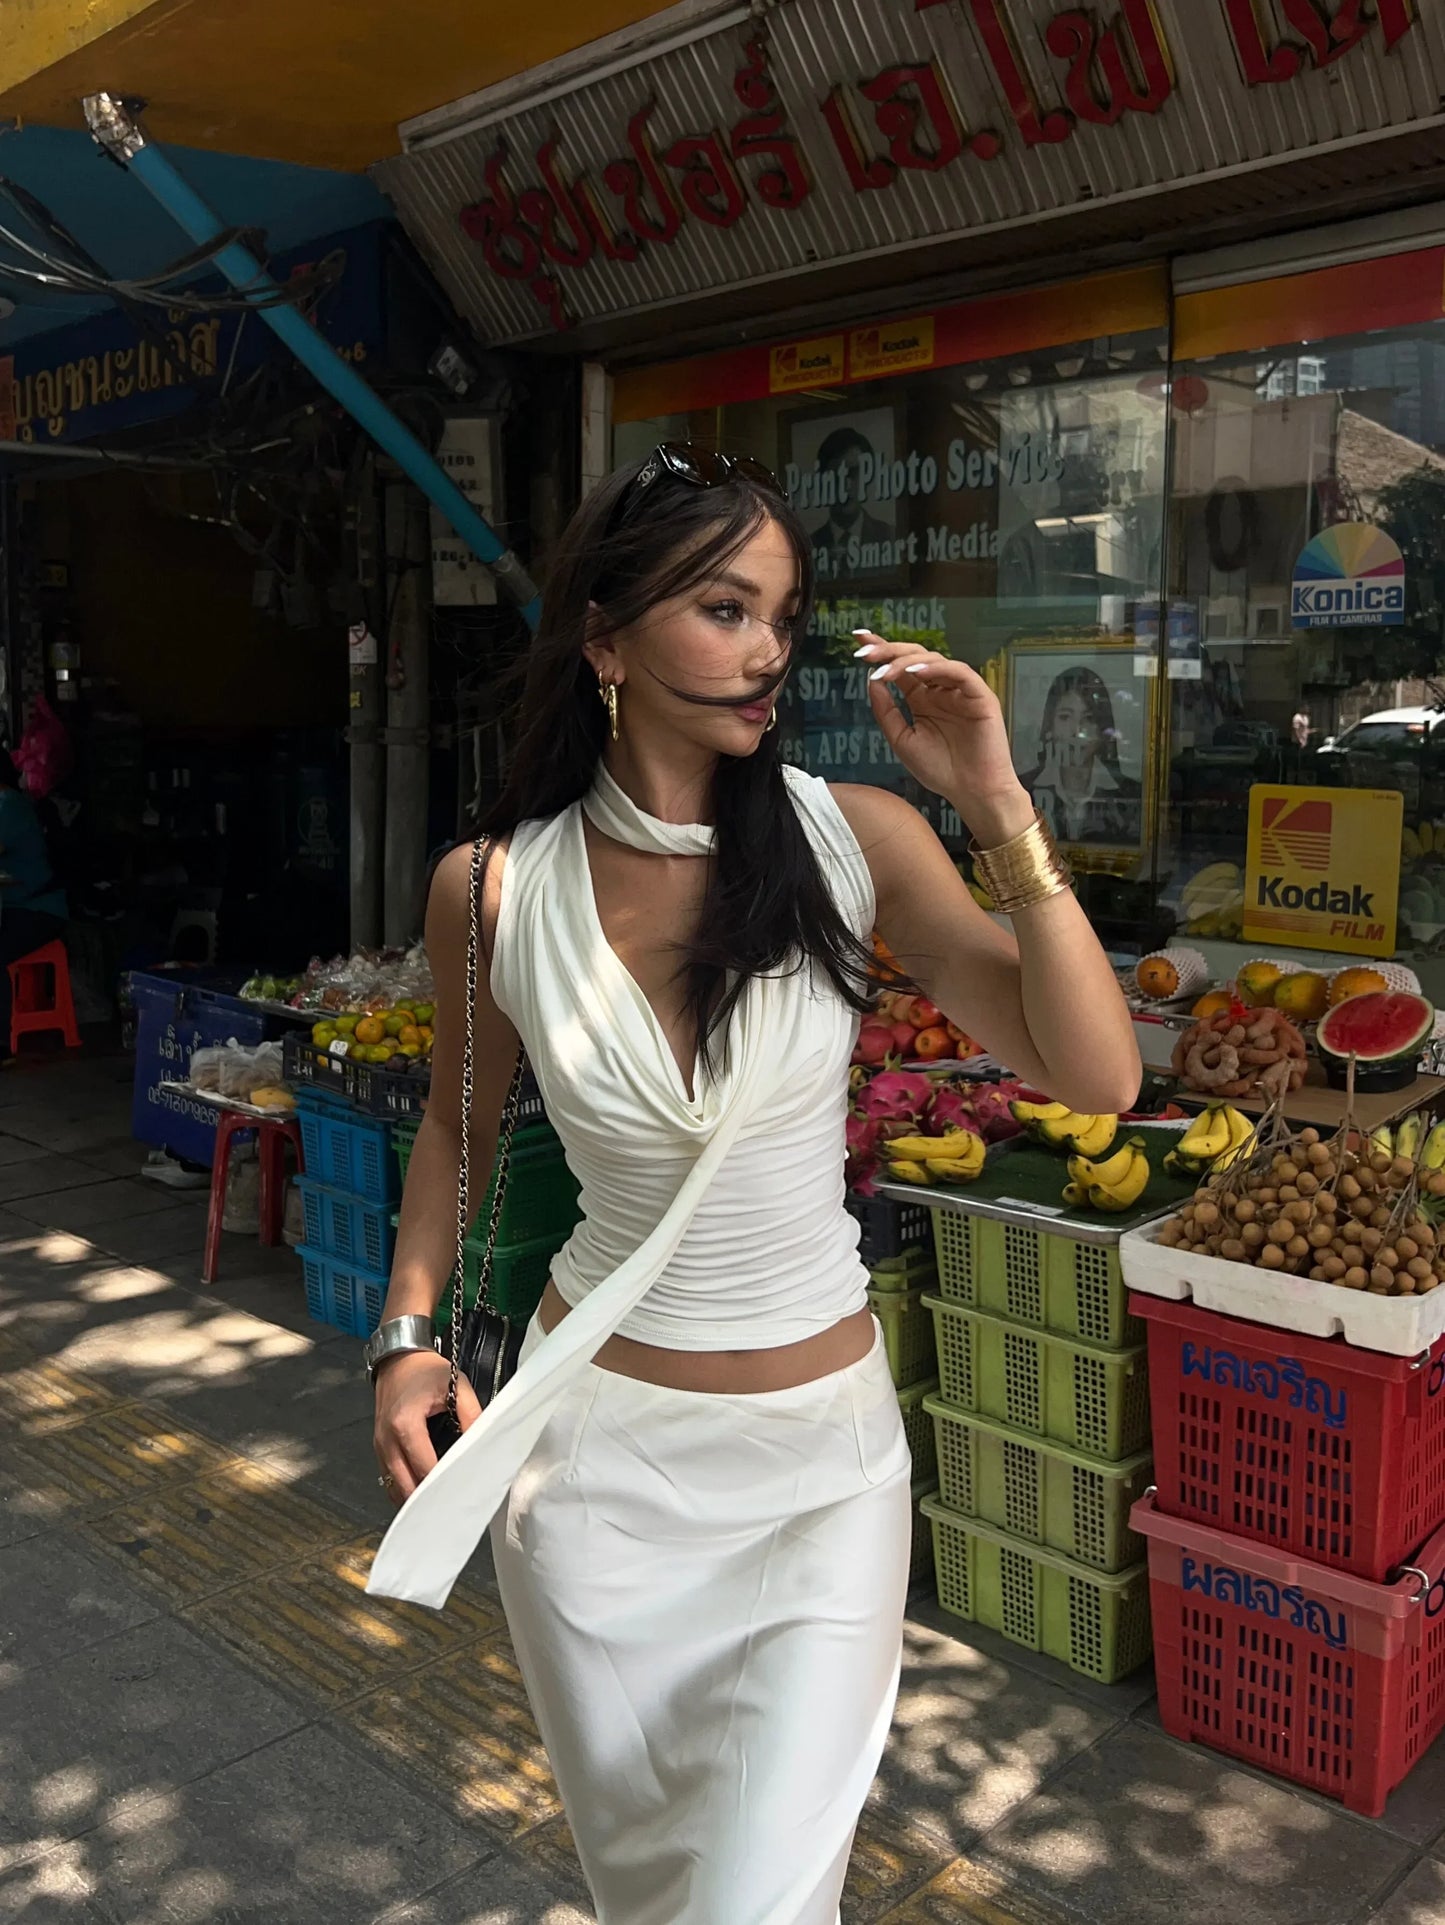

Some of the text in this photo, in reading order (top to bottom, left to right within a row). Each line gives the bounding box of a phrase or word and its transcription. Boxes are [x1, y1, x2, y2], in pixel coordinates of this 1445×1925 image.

[882, 336, 920, 353] Kodak
[799, 354, 832, 369] Kodak
[785, 433, 1065, 511] Print Photo Service
[847, 527, 918, 570] Smart
[926, 522, 1000, 563] Media
[1293, 581, 1403, 613] Konica
[806, 597, 947, 637] emory Stick
[1309, 614, 1329, 626] FILM
[1340, 613, 1383, 625] CAMERAS
[818, 731, 860, 764] APS
[1257, 876, 1375, 918] Kodak
[1329, 920, 1385, 941] FILM
[1182, 1342, 1347, 1430] ผลเจริญ
